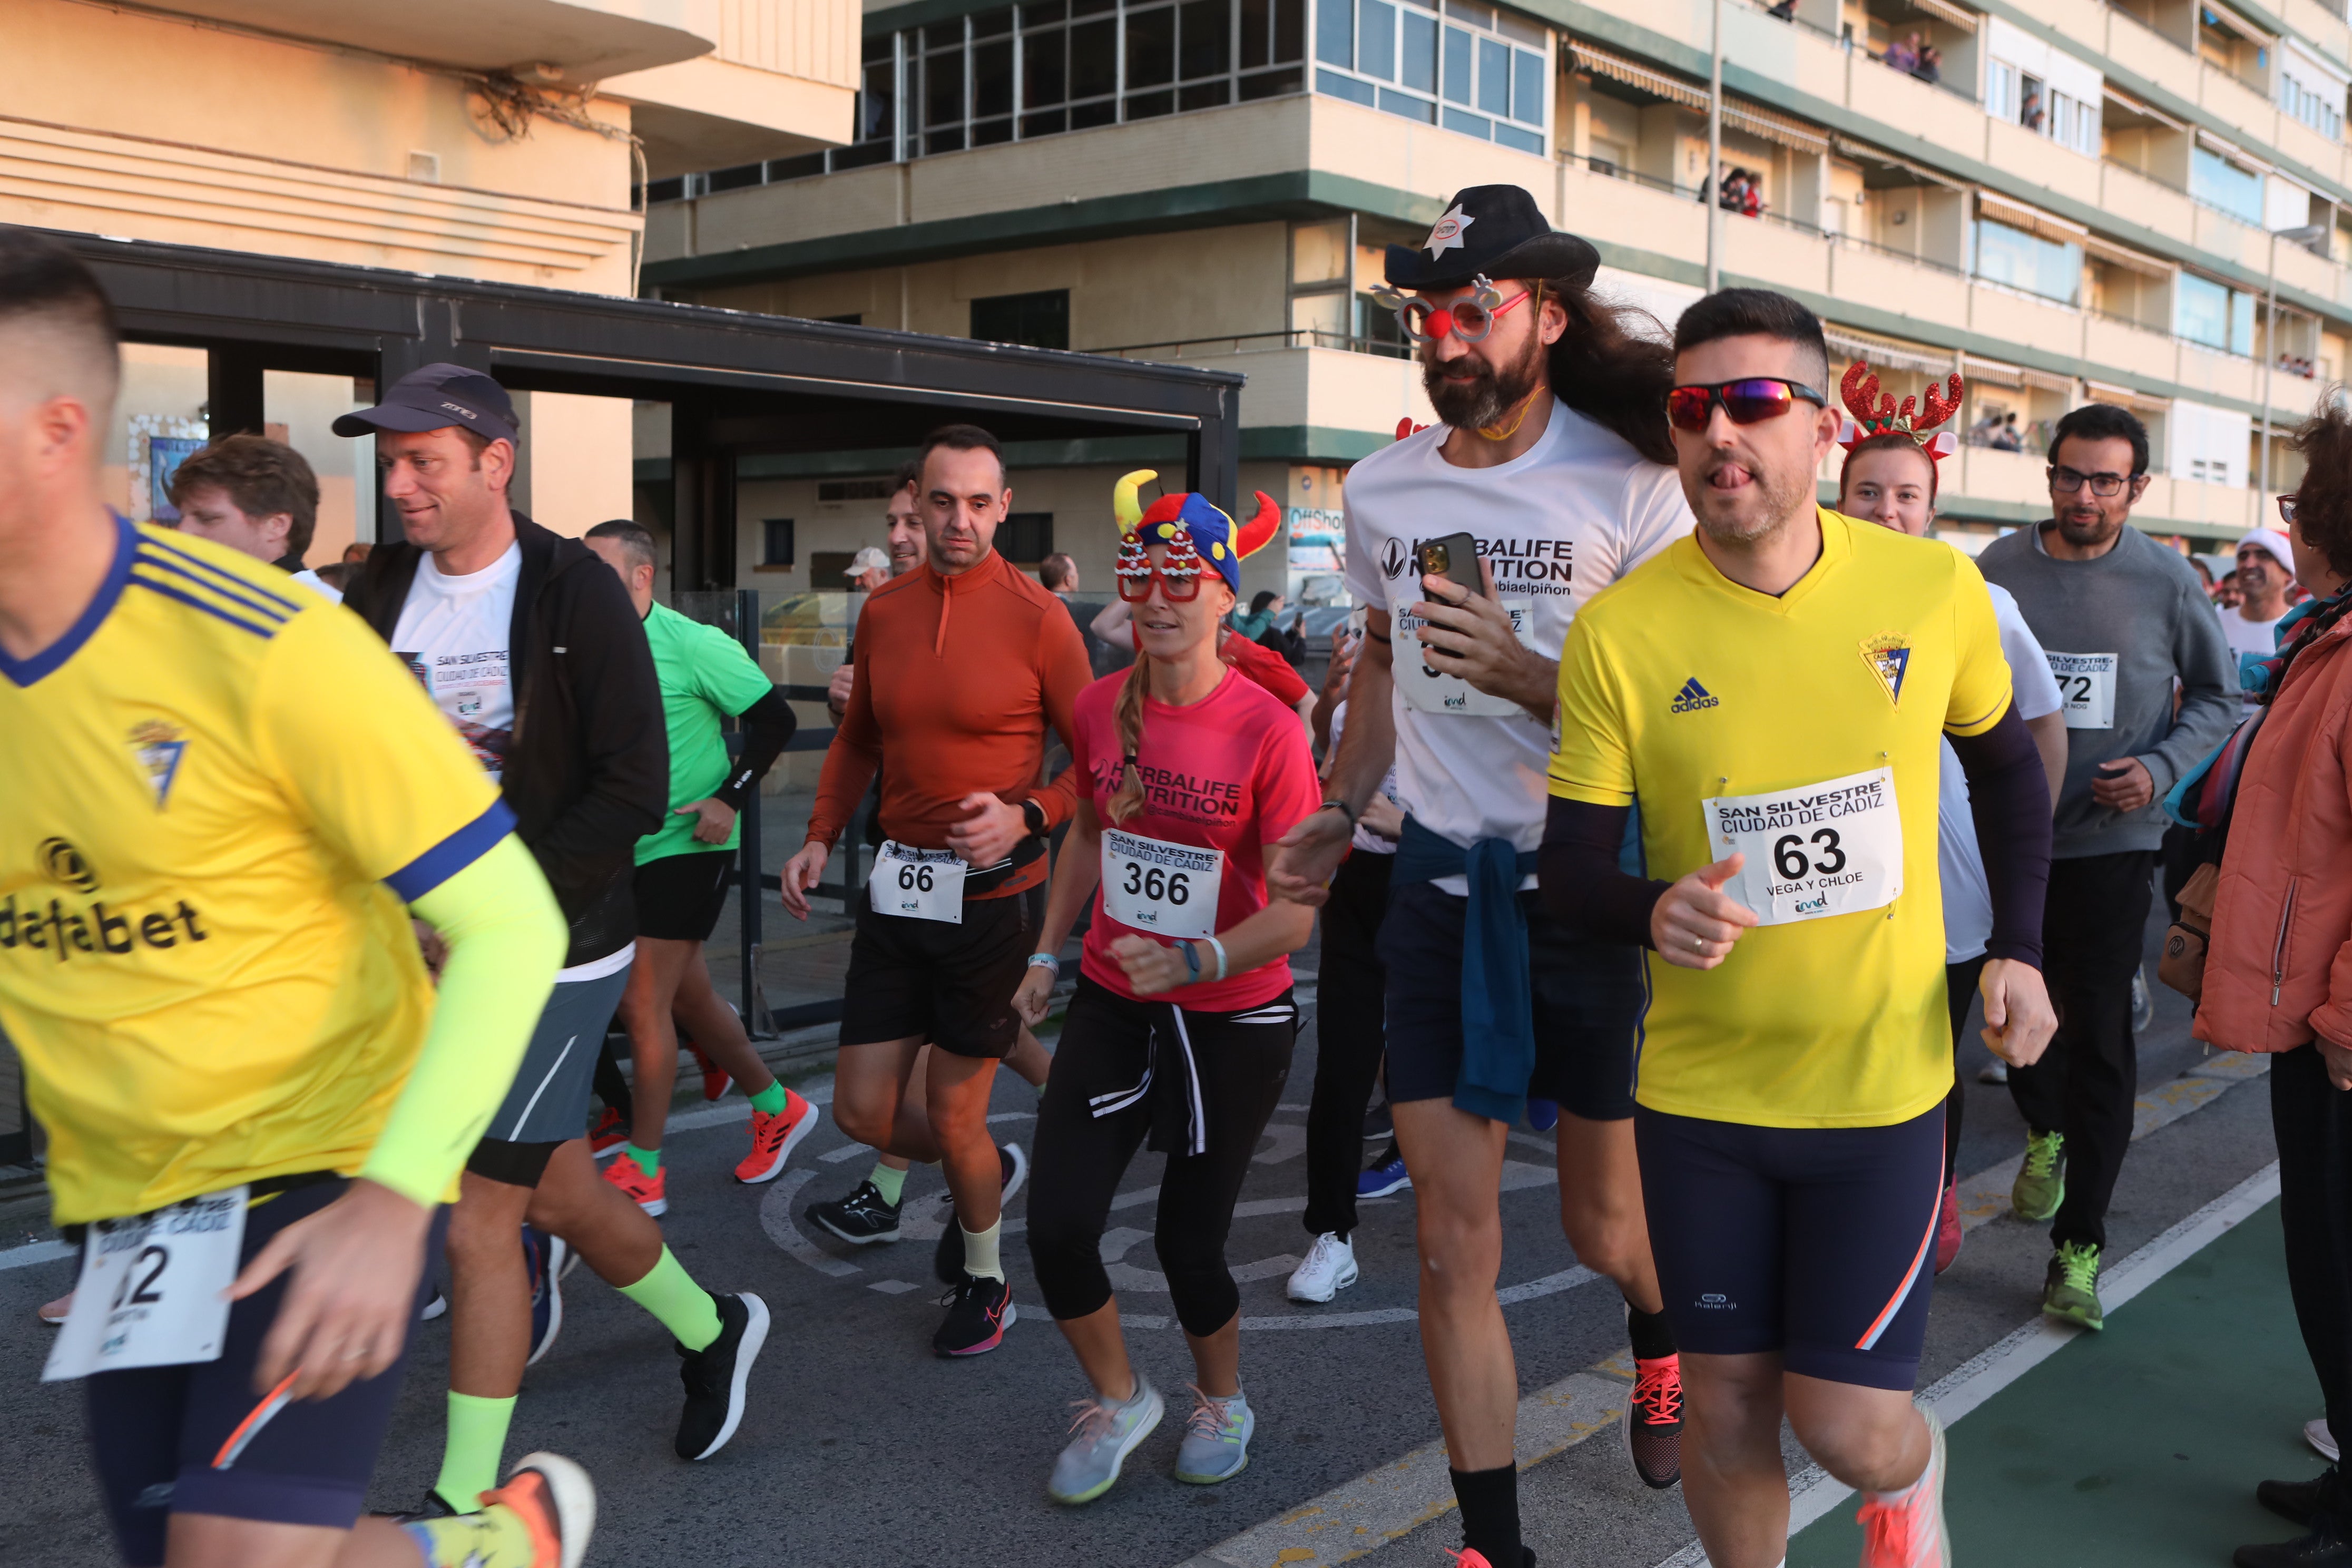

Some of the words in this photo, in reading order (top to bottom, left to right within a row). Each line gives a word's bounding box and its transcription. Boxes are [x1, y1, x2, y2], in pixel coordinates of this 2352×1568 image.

[1412, 538, 1573, 560] HBALIFE
[1409, 560, 1572, 582] NITION
[1671, 696, 1719, 713] adidas
[1106, 778, 1238, 816] NTRITION
[1719, 806, 1760, 818] SAN
[1766, 781, 1881, 815] SILVESTRE
[1721, 814, 1793, 833] CIUDAD
[1799, 807, 1825, 825] DE
[1110, 834, 1135, 847] SAN
[1139, 842, 1214, 862] SILVESTRE
[1110, 841, 1152, 861] CIUDAD
[1155, 853, 1171, 866] DE
[1774, 828, 1846, 880] 63
[898, 864, 934, 892] 66
[1123, 862, 1190, 905] 366
[1767, 882, 1803, 896] VEGA
[1806, 880, 1814, 889] Y
[1819, 872, 1863, 888] CHLOE
[0, 895, 208, 962] dafabet
